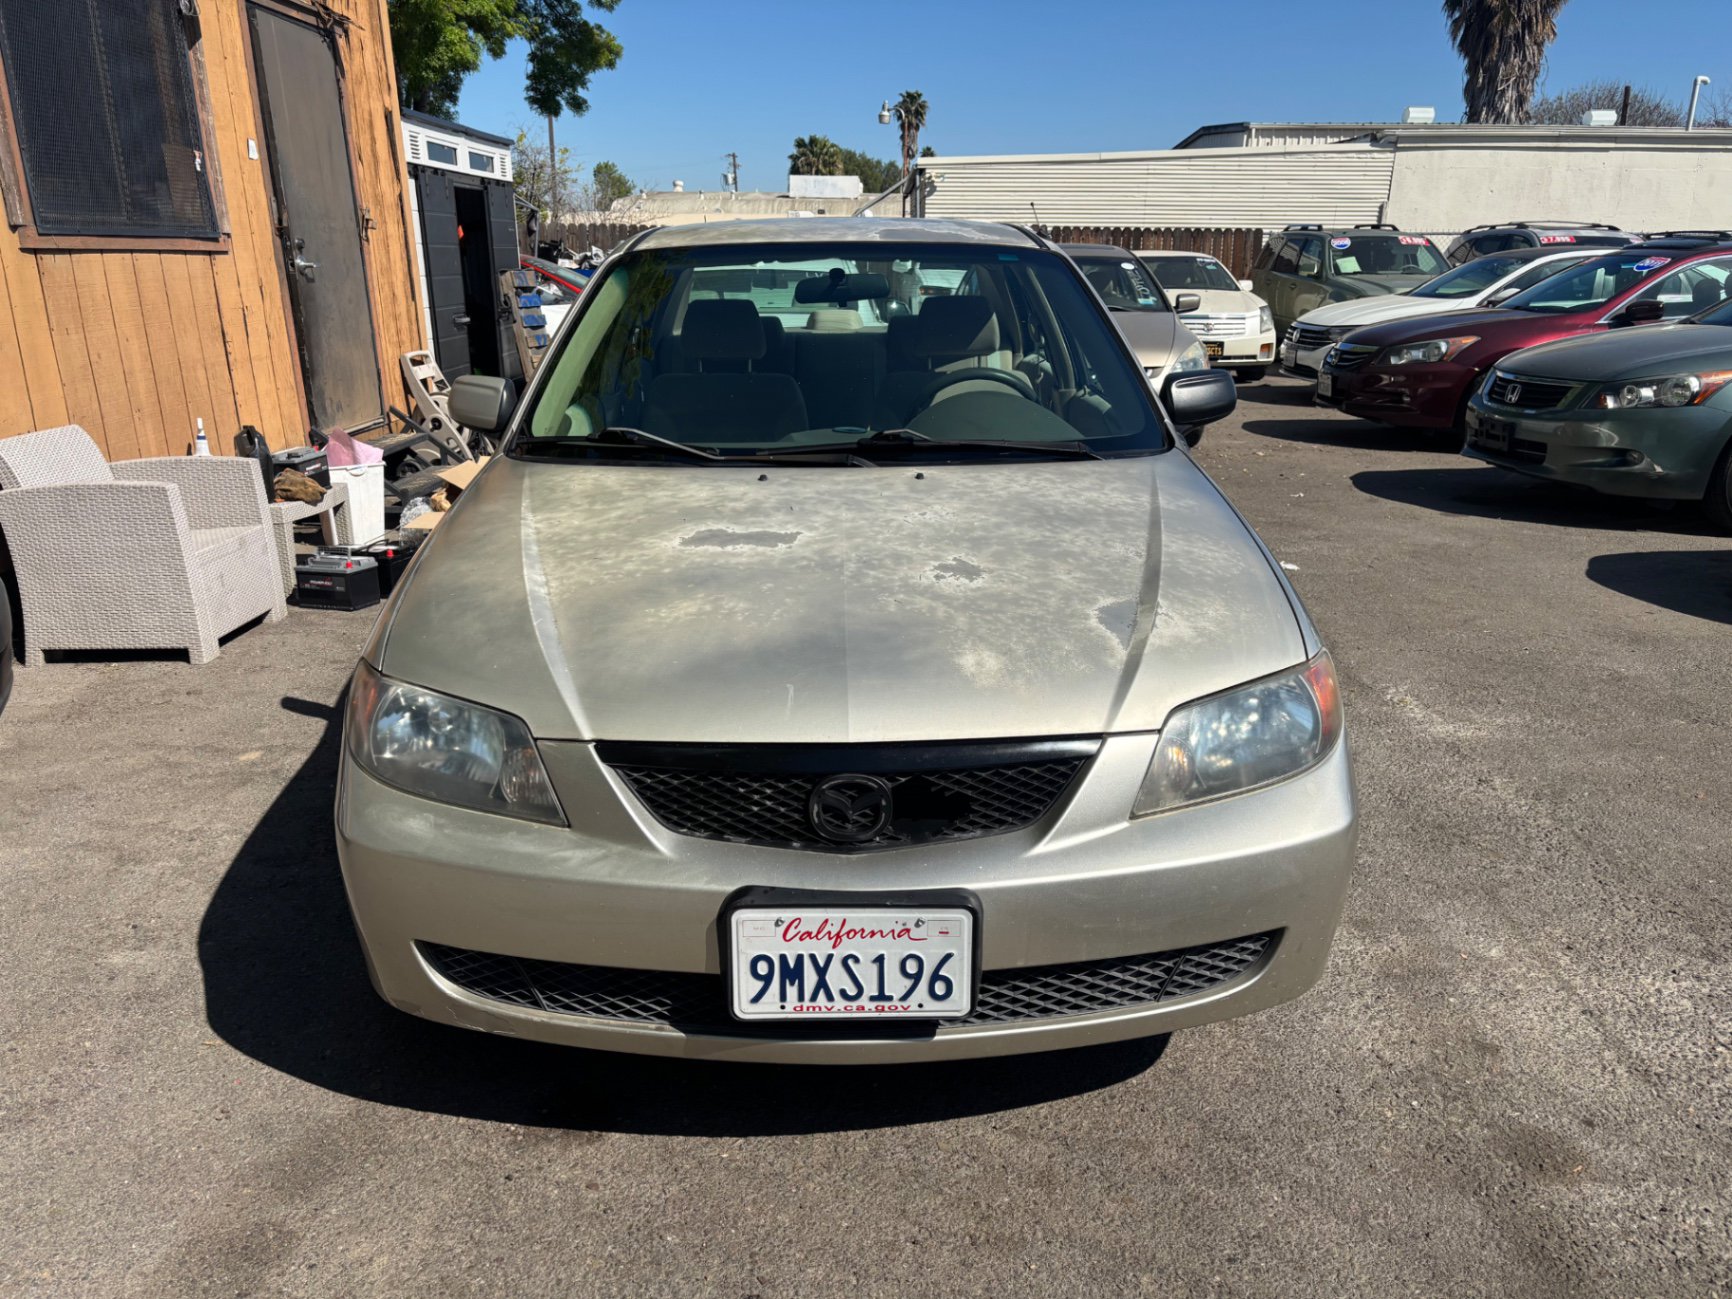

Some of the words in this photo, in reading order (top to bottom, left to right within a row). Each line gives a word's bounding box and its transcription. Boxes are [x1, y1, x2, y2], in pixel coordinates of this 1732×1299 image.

[782, 917, 927, 949] California
[749, 953, 954, 1003] 9MXS196
[793, 1004, 911, 1012] dmv.ca.gov
